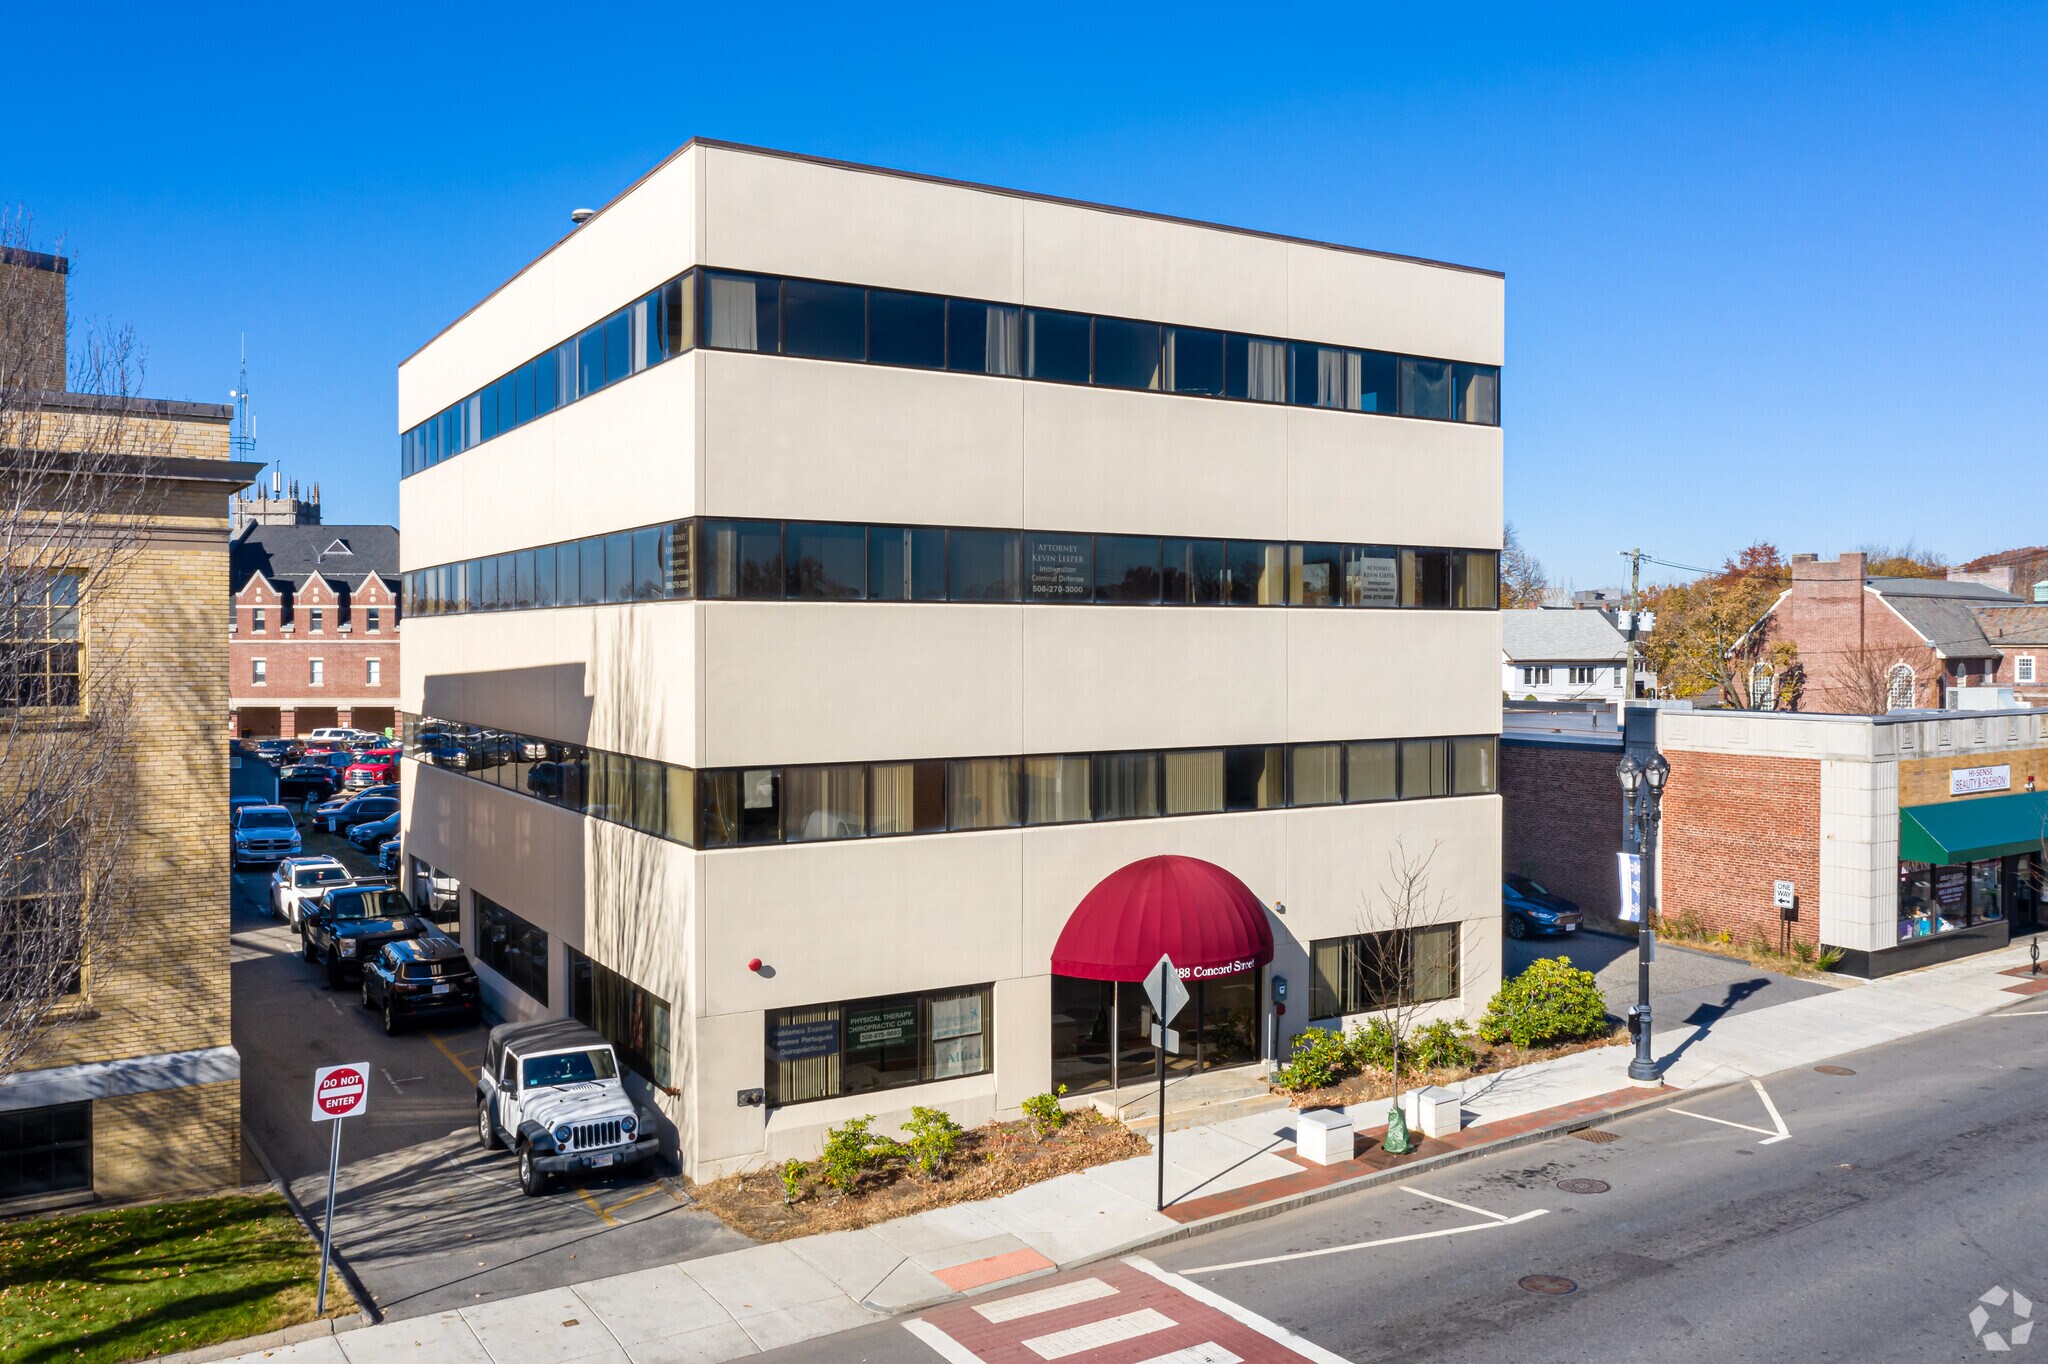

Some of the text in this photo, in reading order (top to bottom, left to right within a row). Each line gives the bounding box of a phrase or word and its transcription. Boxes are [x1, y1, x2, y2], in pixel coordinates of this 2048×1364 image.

[1038, 544, 1078, 552] ATTORNEY
[1032, 554, 1084, 562] KEVIN LEEPER
[1040, 566, 1076, 574] Immigration
[1032, 585, 1084, 593] 508-270-3000
[1968, 768, 1993, 776] HI-SENSE
[1956, 779, 1977, 790] BEAUTY
[1983, 776, 2006, 786] FASHION
[1194, 962, 1232, 978] Concord
[1234, 958, 1255, 972] Street
[850, 1011, 912, 1024] PHYSICAL THERAPY
[848, 1021, 895, 1033] CHIROPRACTIC
[324, 1075, 360, 1088] DO NOT
[326, 1096, 355, 1108] ENTER
